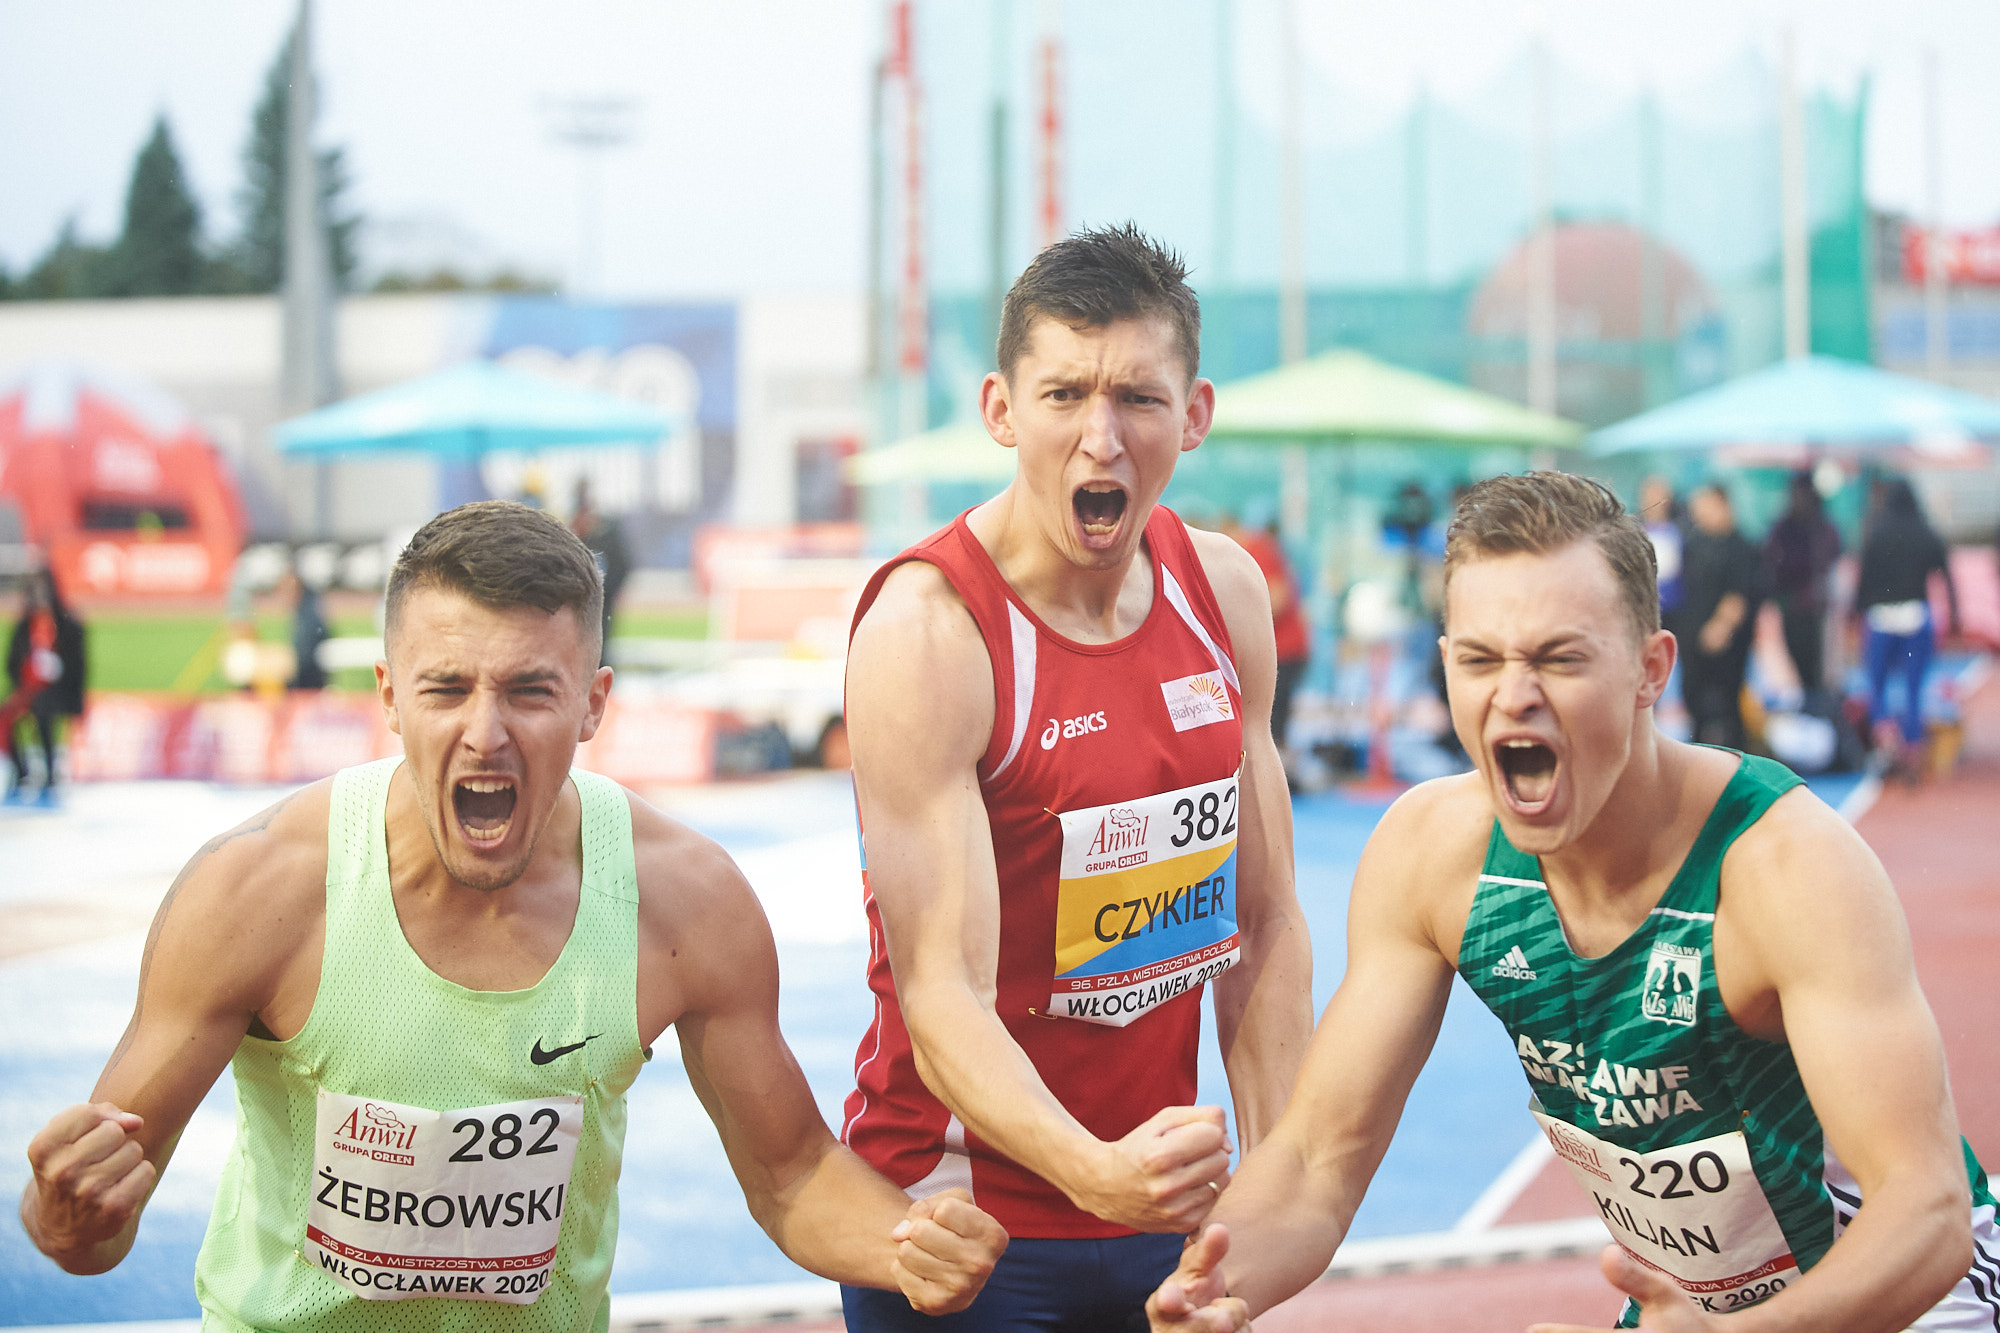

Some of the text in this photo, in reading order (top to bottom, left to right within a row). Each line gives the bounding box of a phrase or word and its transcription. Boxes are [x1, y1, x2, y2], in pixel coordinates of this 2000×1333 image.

[1062, 710, 1108, 739] asics
[1087, 815, 1150, 857] Anwil
[1170, 785, 1237, 848] 382
[1085, 852, 1147, 873] GRUPA ORLEN
[1094, 875, 1226, 943] CZYKIER
[1067, 957, 1231, 1017] WŁOCŁAWEK 2020
[1071, 939, 1233, 990] 96. PZLA MISTRZOSTWA POLSKI
[1492, 964, 1537, 981] adidas
[1590, 1058, 1690, 1096] AWF
[333, 1141, 413, 1165] GRUPA ORLEN
[334, 1105, 561, 1163] Anwil 282
[316, 1165, 565, 1228] ŻEBROWSKI
[1619, 1150, 1729, 1200] 220
[1593, 1190, 1721, 1257] KILJAN
[319, 1250, 550, 1295] WŁOCŁAWEK 2020
[321, 1235, 551, 1270] 96. PZLA MISTRZOSTWA POLSKI
[1725, 1278, 1787, 1308] 2020
